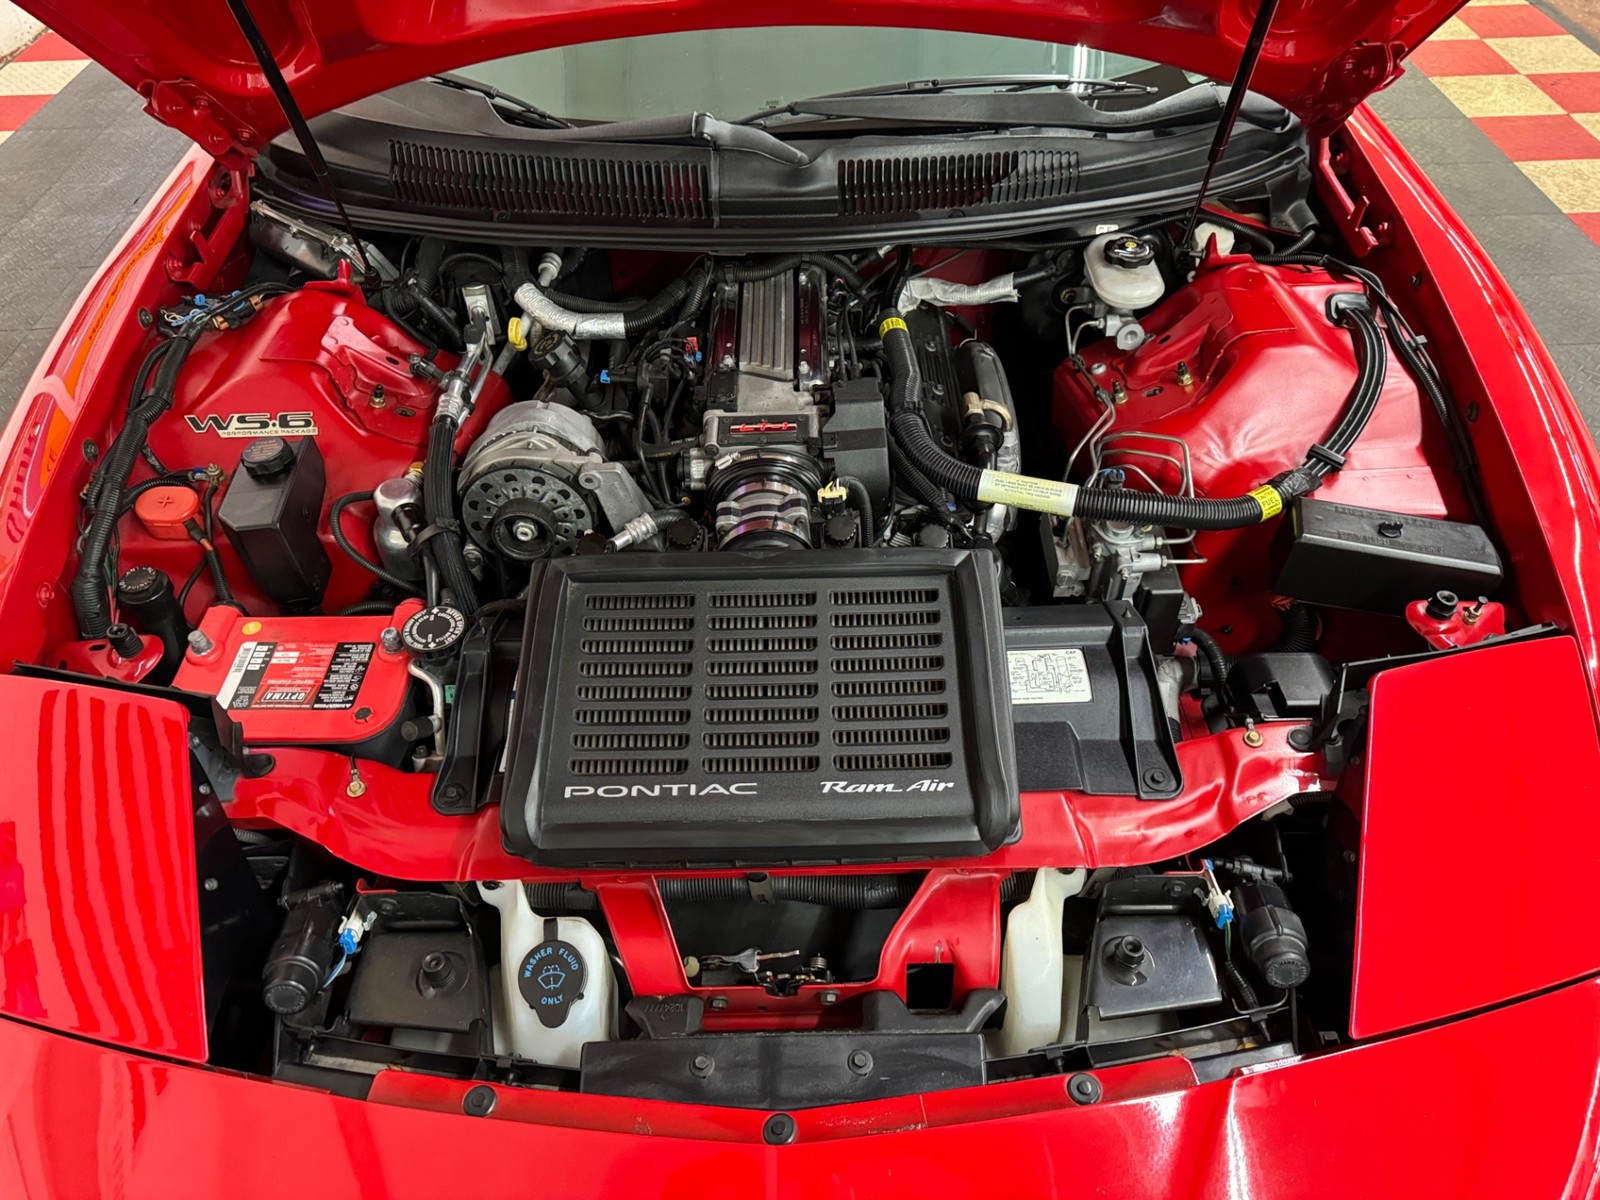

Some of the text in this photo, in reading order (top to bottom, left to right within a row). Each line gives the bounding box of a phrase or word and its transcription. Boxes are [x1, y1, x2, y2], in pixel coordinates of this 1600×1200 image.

[1262, 497, 1279, 508] FUEL
[265, 691, 307, 700] OPTIMA
[564, 782, 758, 799] PONTIAC
[820, 779, 955, 794] Ram Air
[523, 946, 579, 978] WASHER FLUID
[541, 994, 563, 1005] ONLY
